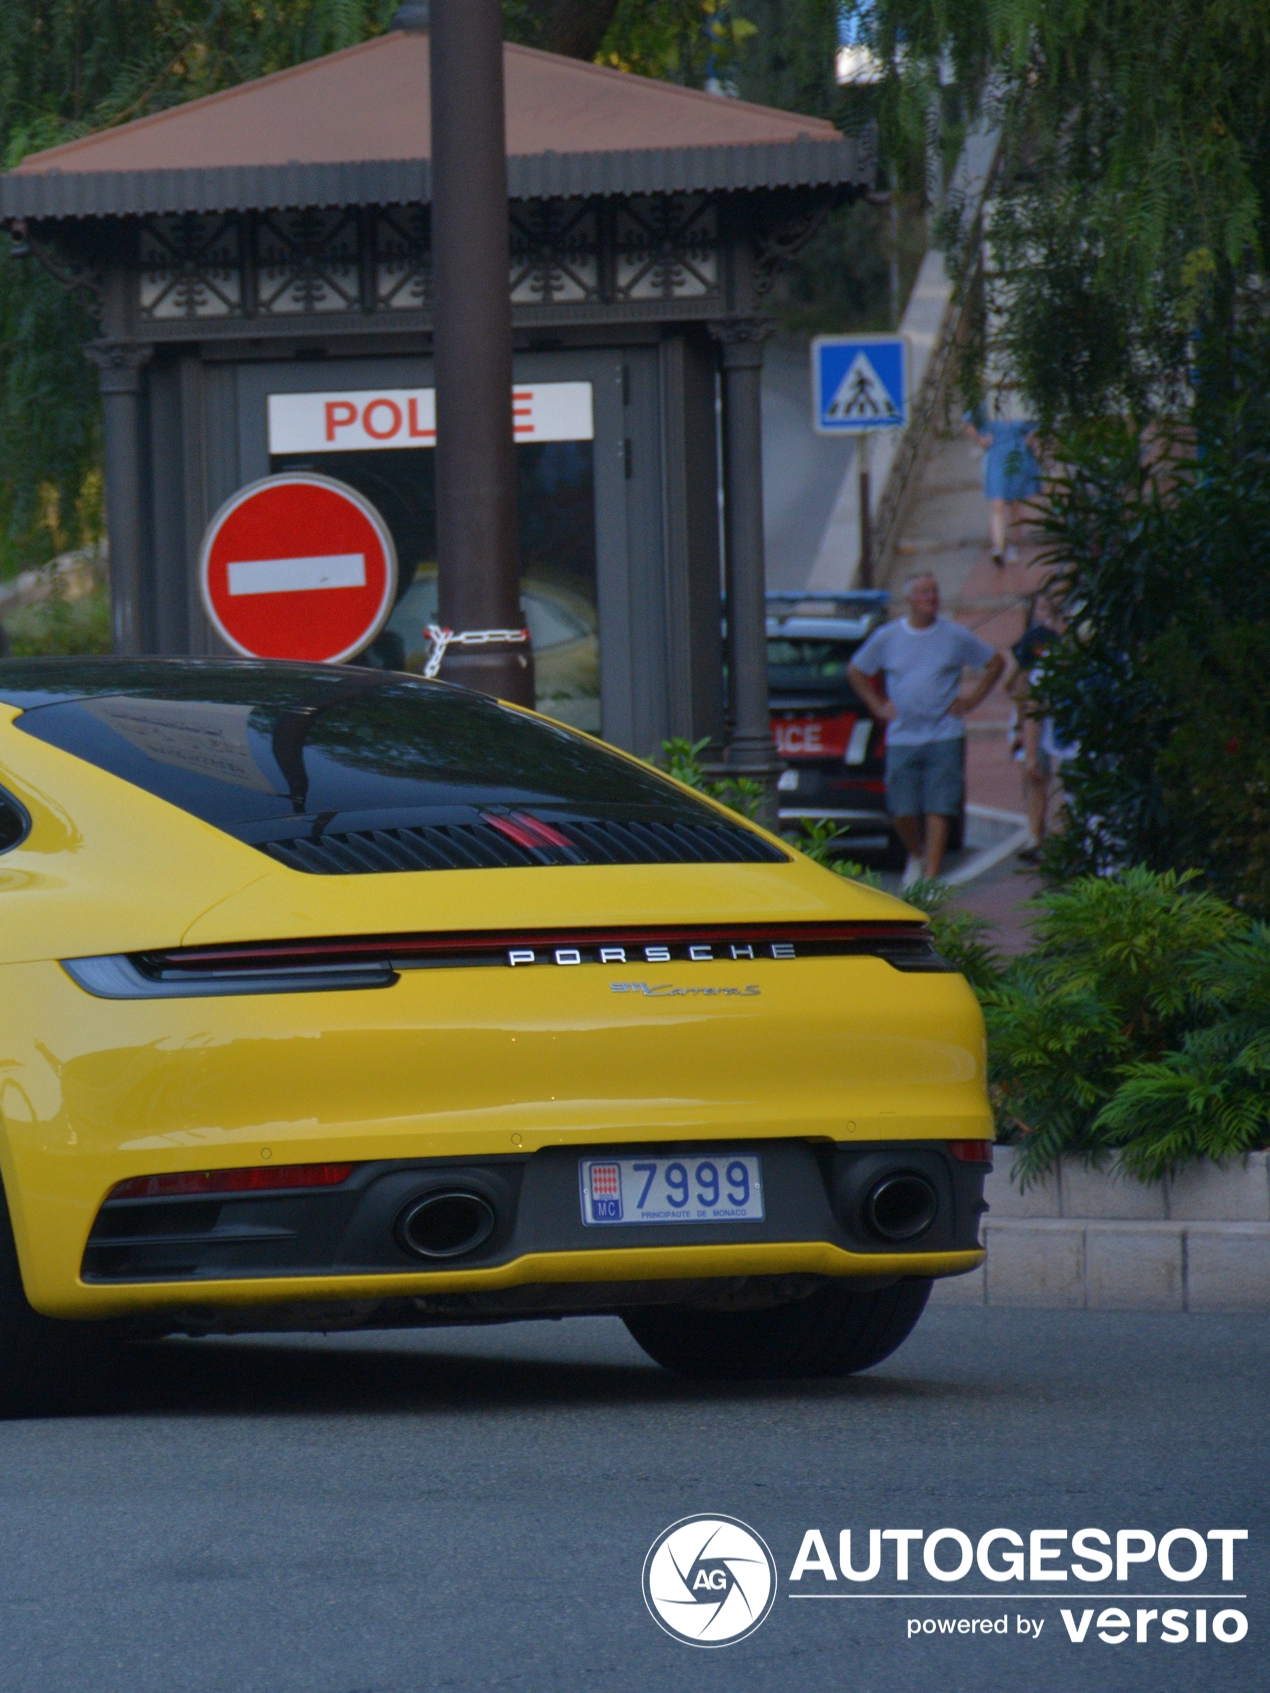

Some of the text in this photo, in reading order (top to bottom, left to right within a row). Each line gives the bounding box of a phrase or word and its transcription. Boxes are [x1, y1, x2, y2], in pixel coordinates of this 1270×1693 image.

[324, 392, 535, 442] POLE
[775, 725, 823, 752] ICE
[508, 943, 797, 966] PORSCHE
[632, 1160, 750, 1209] 7999
[598, 1202, 616, 1217] MC
[641, 1209, 747, 1219] PRINCIPAUTE DE MONACO
